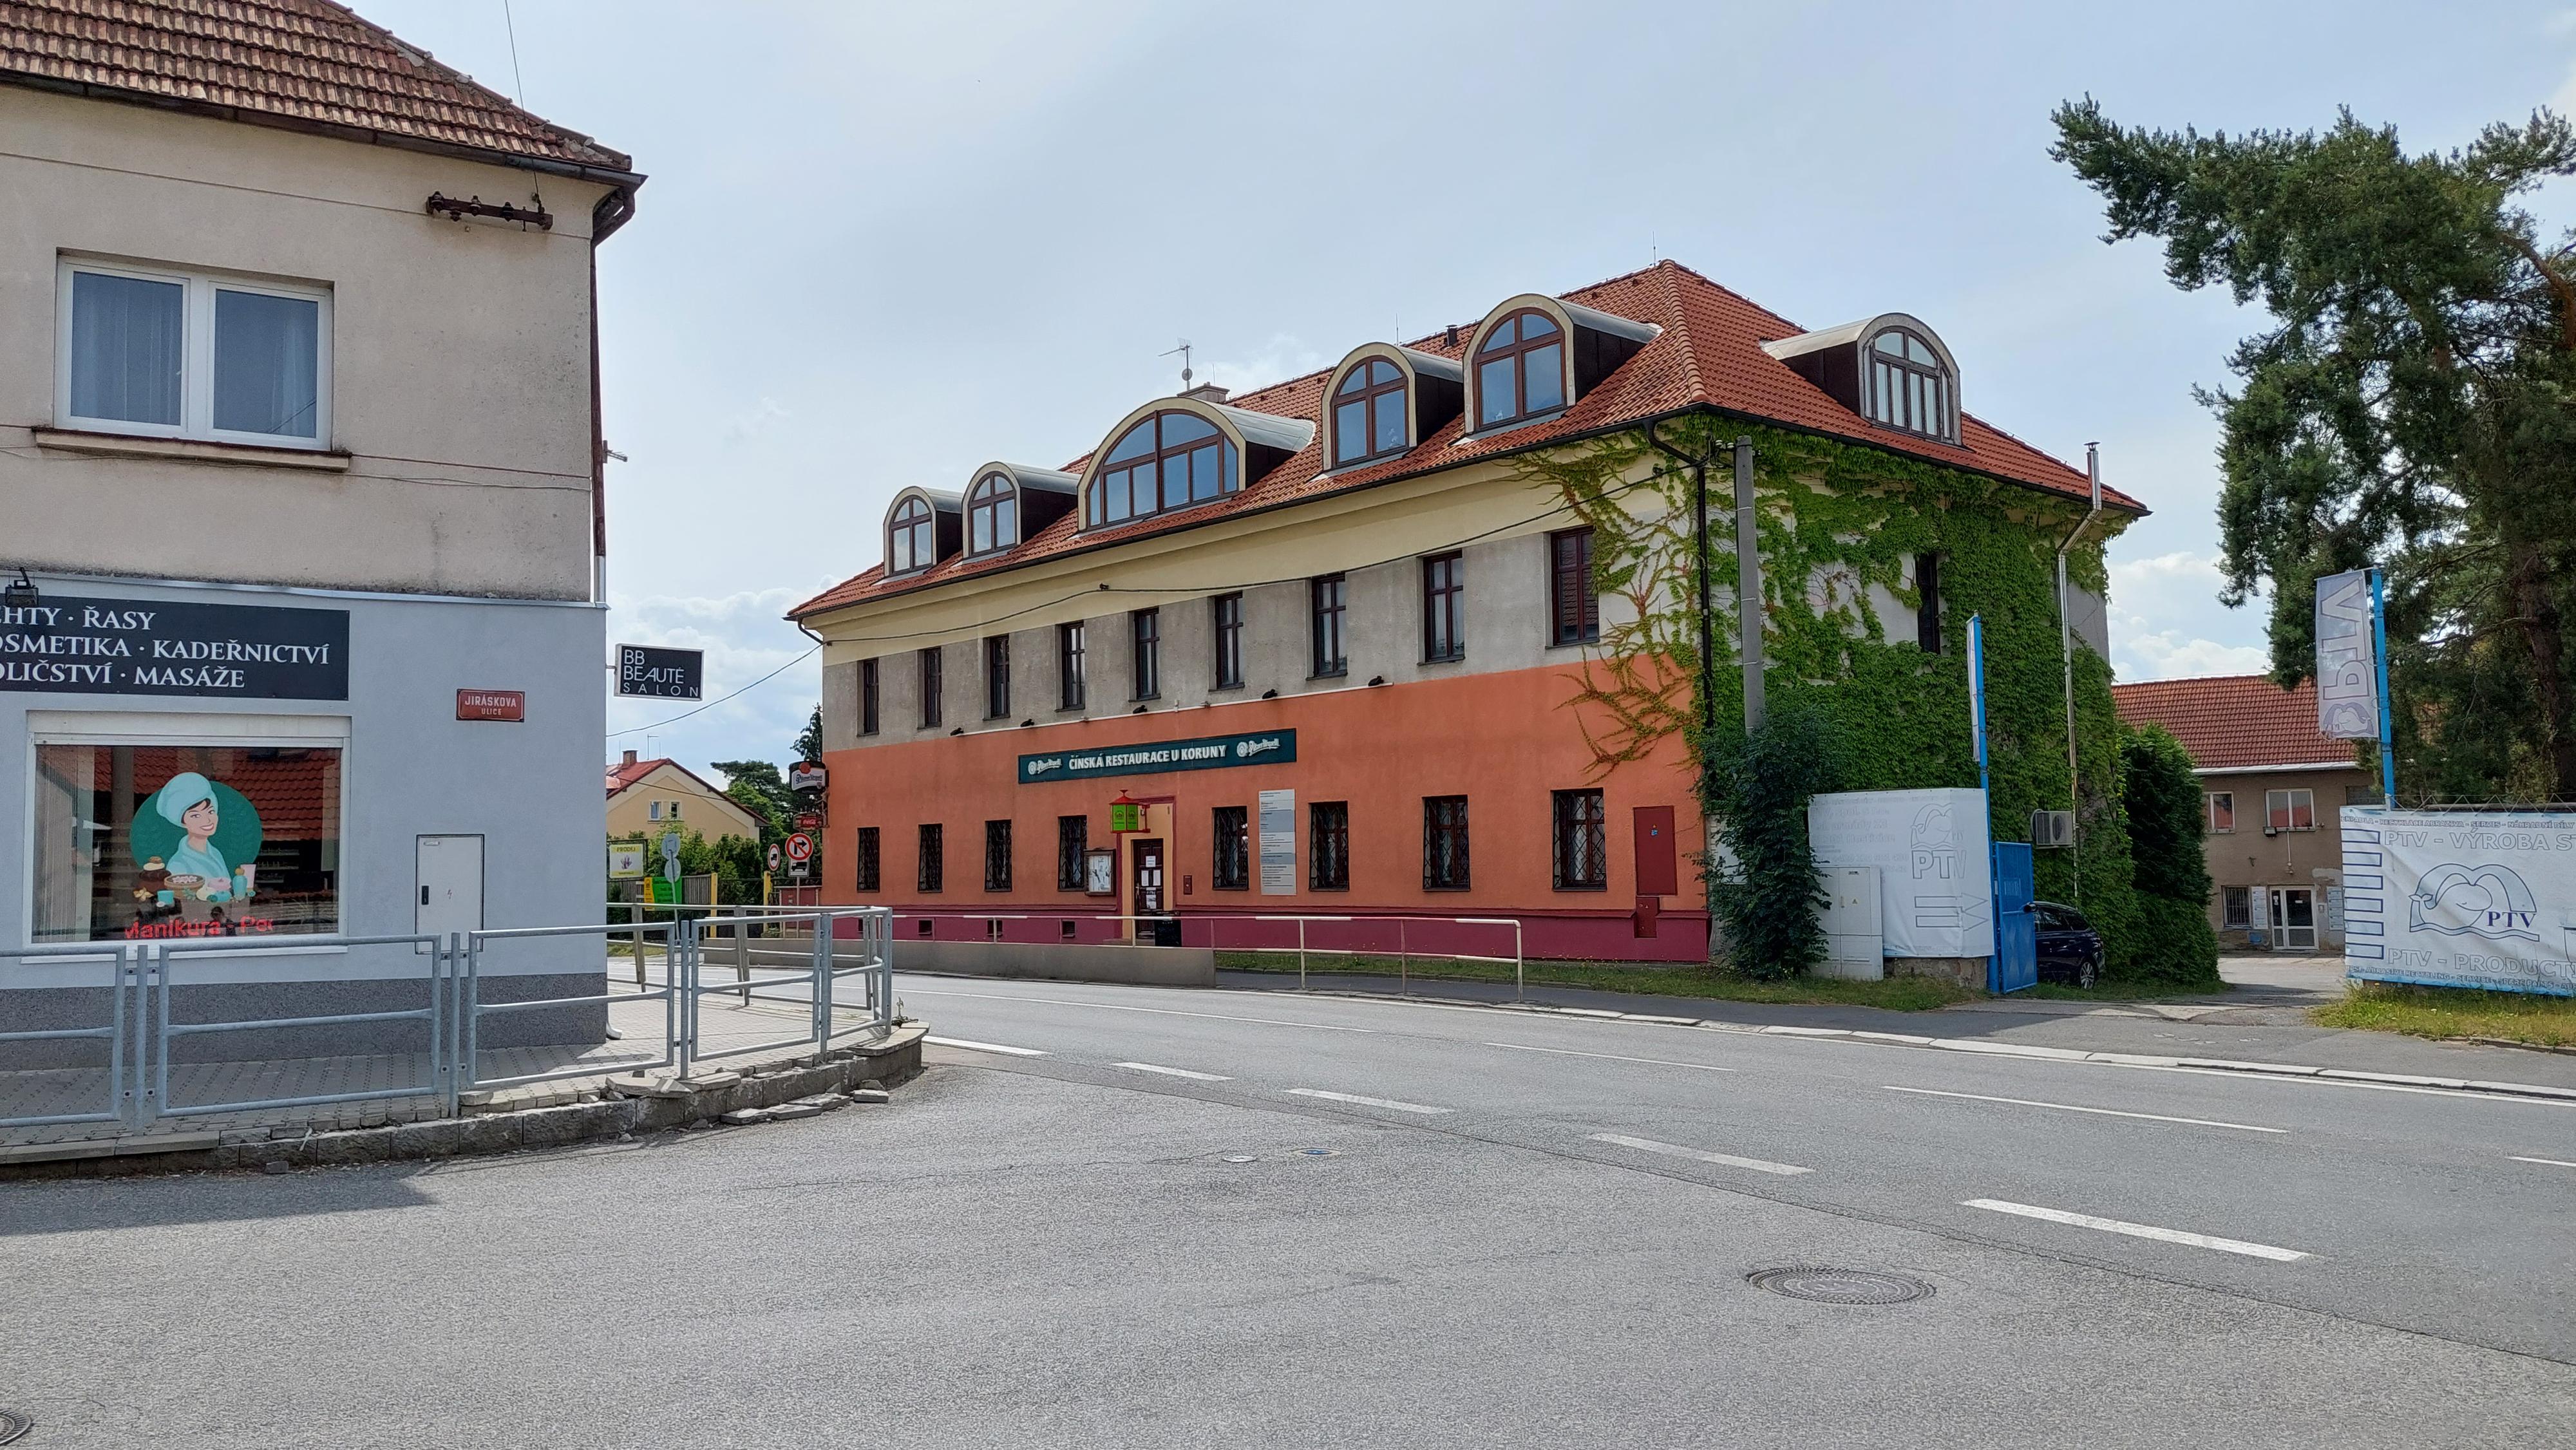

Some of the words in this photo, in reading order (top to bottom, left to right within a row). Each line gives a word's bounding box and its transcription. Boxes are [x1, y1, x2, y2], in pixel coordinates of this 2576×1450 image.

[0, 605, 62, 626] HTY
[82, 605, 156, 630] ŘASY
[0, 634, 132, 657] SMETIKA
[152, 639, 330, 664] KADEŘNICTVÍ
[623, 649, 645, 665] BB
[0, 659, 113, 684] LIČSTVÍ
[133, 665, 245, 688] MASÁŽE
[623, 666, 685, 684] BEAUTÉ
[623, 683, 698, 697] SALON
[464, 693, 516, 708] JIRÁSKOVA
[481, 708, 502, 716] ULICE
[1069, 753, 1104, 770] ČÍNSKÁ
[1105, 750, 1170, 767] RESTAURACE
[1171, 749, 1180, 762] U
[1181, 744, 1227, 761] KORUNY
[2384, 830, 2428, 848] PTV
[2449, 827, 2550, 851] VÝROBA
[1911, 849, 1967, 880] PTV
[2486, 910, 2537, 928] PTV
[2388, 948, 2432, 967] PTV
